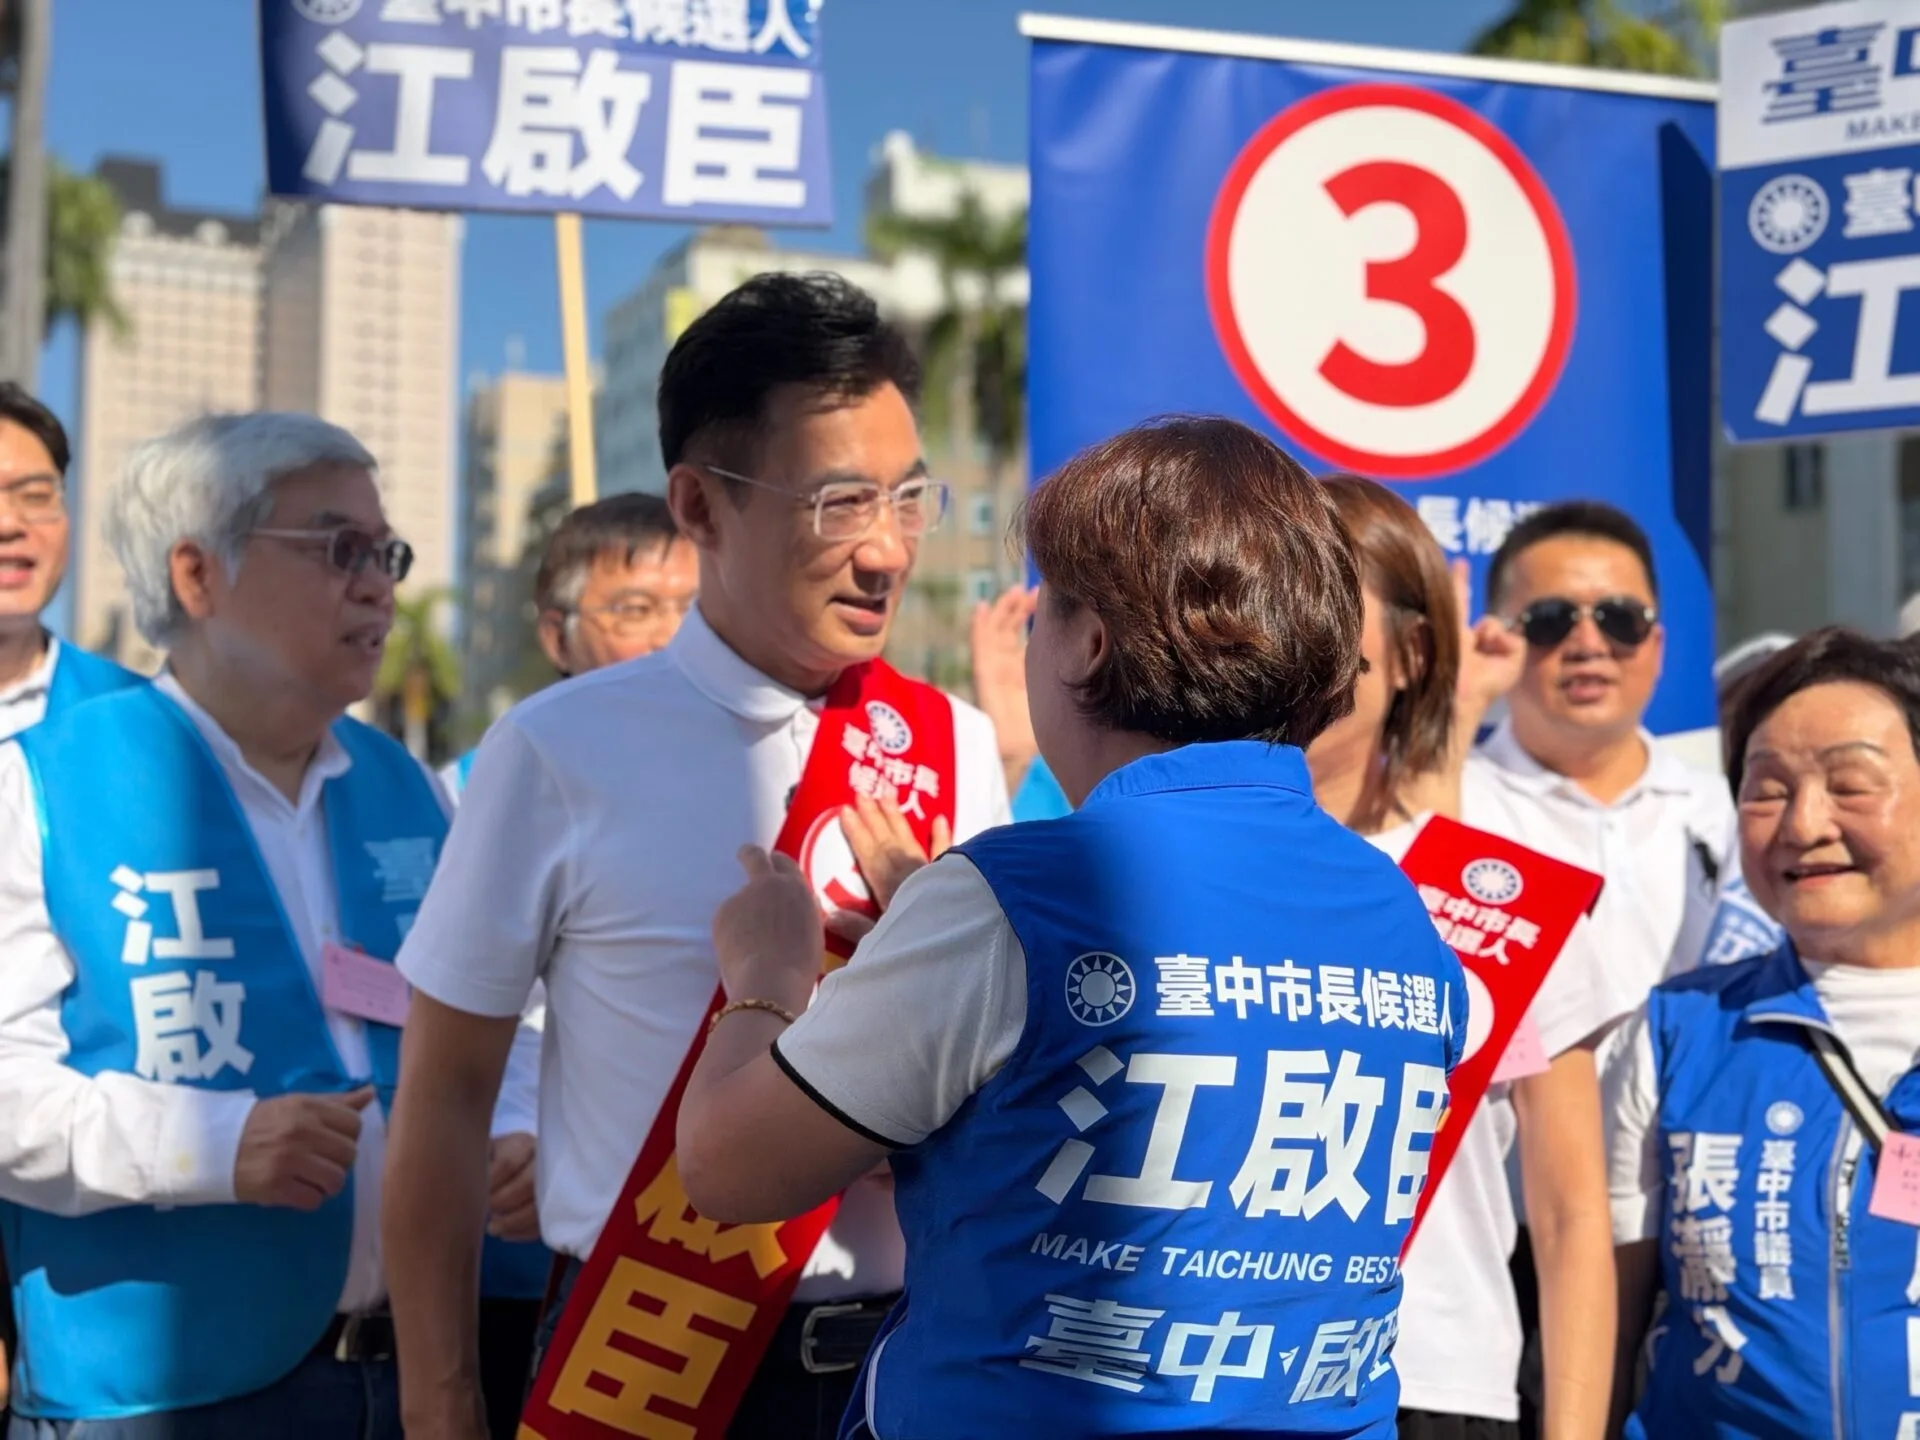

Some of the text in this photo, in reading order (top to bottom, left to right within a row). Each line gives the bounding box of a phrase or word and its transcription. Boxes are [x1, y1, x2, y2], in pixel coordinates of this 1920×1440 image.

[302, 30, 812, 207] 江啟臣
[1842, 168, 1920, 238] 臺
[1317, 160, 1476, 410] 3
[1754, 254, 1920, 426] 江
[1417, 495, 1541, 554] 長候
[109, 864, 255, 1083] 江啟
[1154, 953, 1454, 1035] 臺中市長候選人
[1030, 1232, 1146, 1275] MAKE
[1161, 1246, 1333, 1283] TAICHUNG
